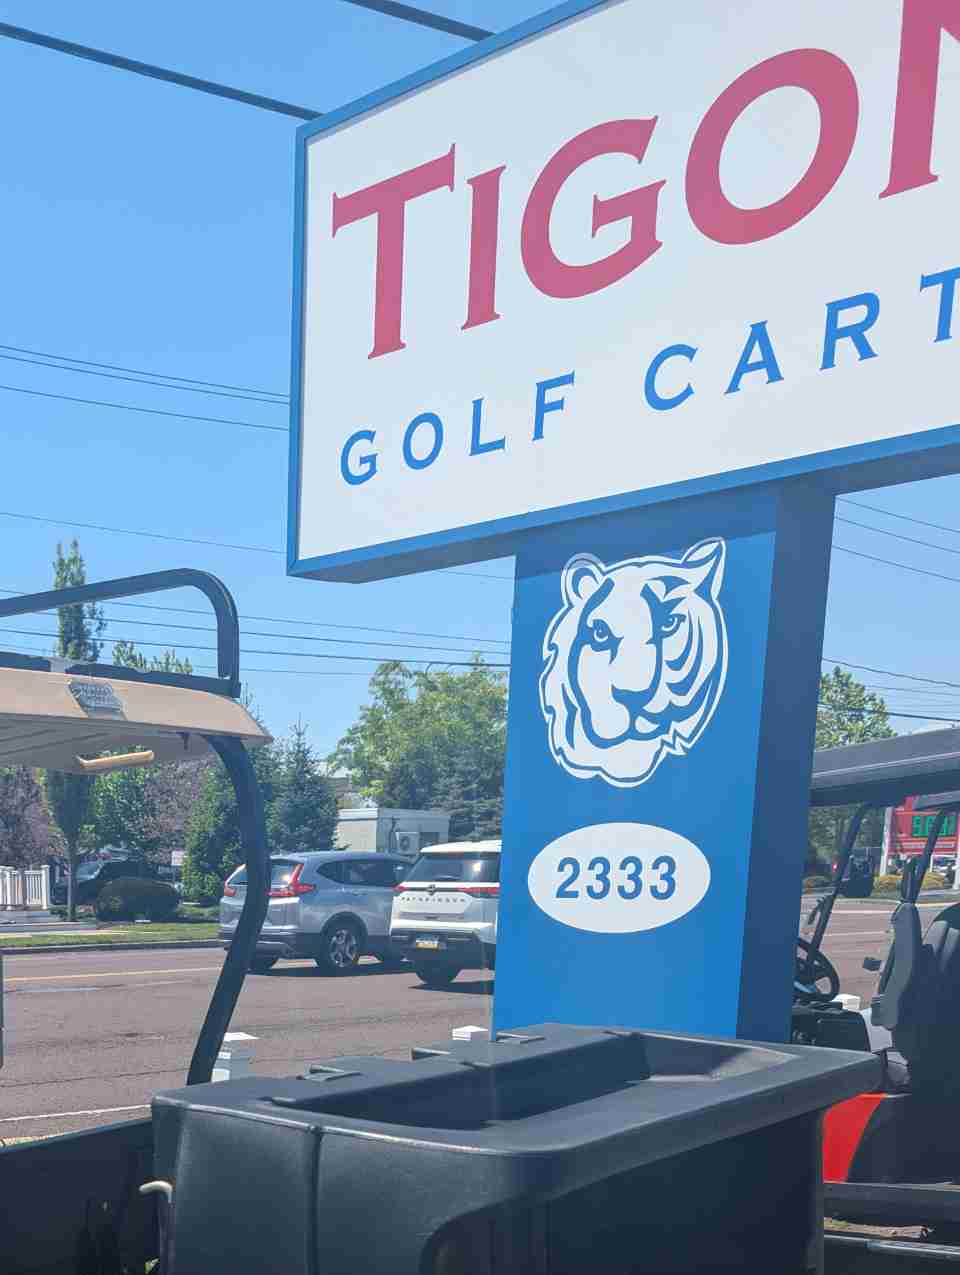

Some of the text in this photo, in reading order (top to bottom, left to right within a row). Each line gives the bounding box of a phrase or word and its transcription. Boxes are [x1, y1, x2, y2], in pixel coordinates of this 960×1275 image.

[340, 266, 960, 485] GOLF CART
[555, 855, 677, 900] 2333
